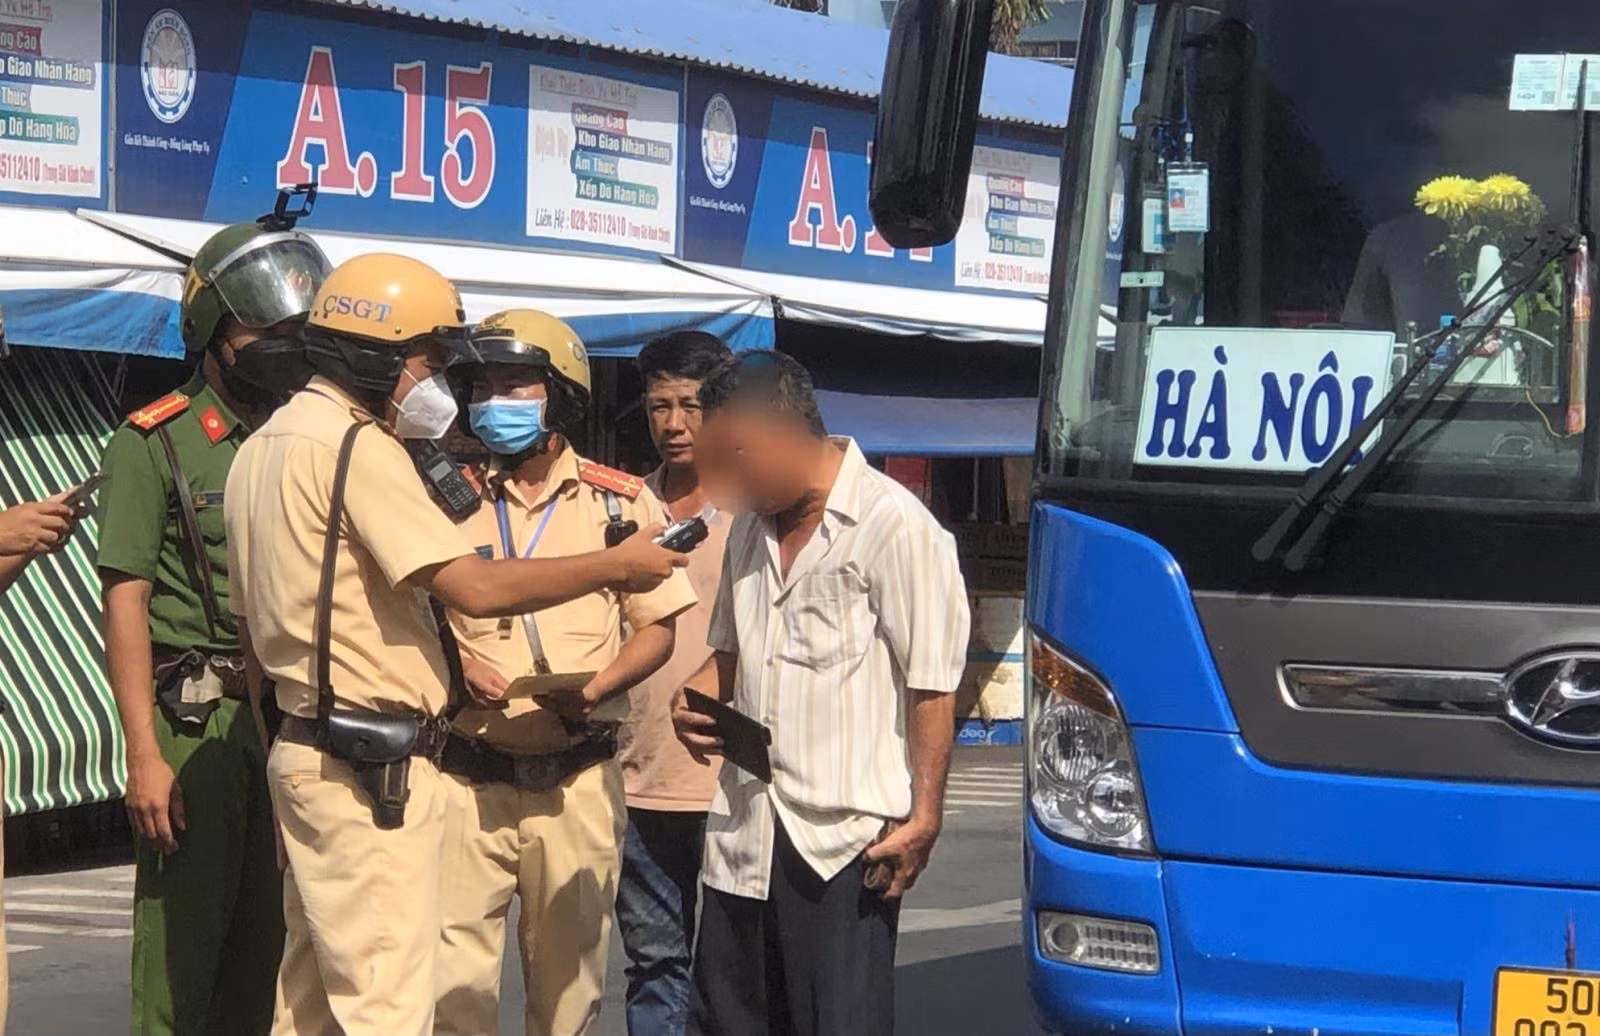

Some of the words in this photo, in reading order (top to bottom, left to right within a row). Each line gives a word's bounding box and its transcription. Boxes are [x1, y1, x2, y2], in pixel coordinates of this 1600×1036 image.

[8, 56, 32, 77] Giao
[578, 130, 597, 147] Kho
[599, 133, 620, 151] Giao
[0, 153, 40, 182] 5112410
[323, 294, 392, 323] CSGT
[1146, 345, 1231, 460] HÀ
[1546, 977, 1600, 1016] 50
